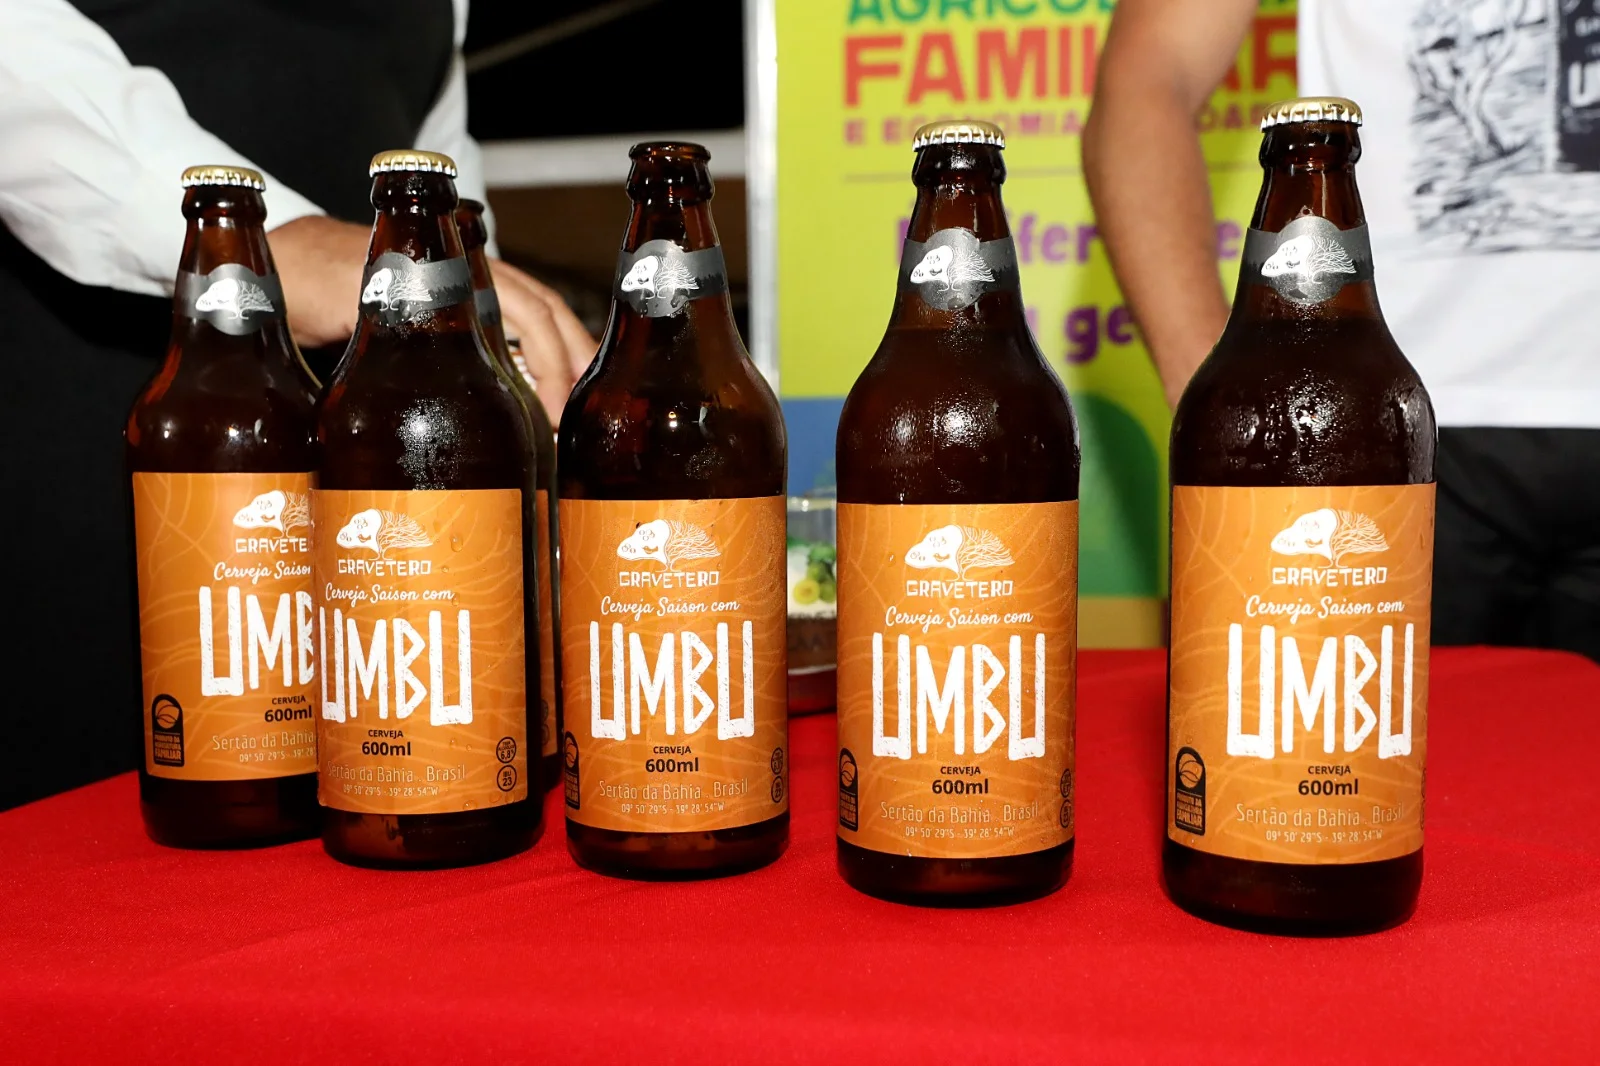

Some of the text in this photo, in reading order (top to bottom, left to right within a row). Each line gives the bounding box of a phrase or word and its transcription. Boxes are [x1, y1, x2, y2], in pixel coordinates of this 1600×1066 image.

[235, 537, 309, 553] GRAVETE
[214, 560, 311, 585] Cerveja Saiso
[338, 559, 432, 576] GRAVETERO
[1272, 567, 1388, 586] GRAVETERO
[619, 571, 720, 588] GRAVETERO
[325, 582, 455, 608] Cerveja Saison com
[906, 580, 1014, 598] GRAVETERO
[601, 596, 740, 622] Cerveja Saison com
[1246, 595, 1405, 624] Cerveja Saison com
[886, 606, 1033, 633] Cerveja Saison com
[199, 586, 314, 696] UMB
[319, 606, 472, 726] UMBU
[590, 620, 754, 740] UMBU
[272, 695, 306, 705] CERVEJA
[872, 632, 1045, 760] UMBU
[1226, 623, 1414, 759] UMBU
[264, 704, 312, 722] 600ml
[212, 730, 314, 750] Sertão da Bahia
[368, 729, 404, 738] CERVEJA
[362, 742, 411, 756] 600ml
[653, 746, 692, 756] CERVEJA
[359, 766, 372, 782] da
[377, 766, 414, 782] Bahia
[426, 764, 465, 782] Brasil
[645, 758, 699, 772] 600ml
[940, 766, 980, 776] CERVEJA
[1308, 766, 1352, 776] CERVEJA
[502, 776, 512, 786] 23
[600, 780, 638, 798] Sertão
[642, 786, 658, 800] da
[663, 784, 700, 800] Bahia
[714, 778, 748, 798] Brasil
[932, 778, 988, 794] 600ml
[1298, 779, 1358, 795] 600ml
[881, 802, 922, 822] Sertão
[928, 806, 944, 822] da
[950, 806, 990, 824] Bahia
[1004, 803, 1038, 822] Brasil
[1236, 804, 1287, 825] Sertão
[1294, 808, 1312, 826] da
[1318, 808, 1360, 827] Bahia
[1372, 804, 1404, 824] Brasil
